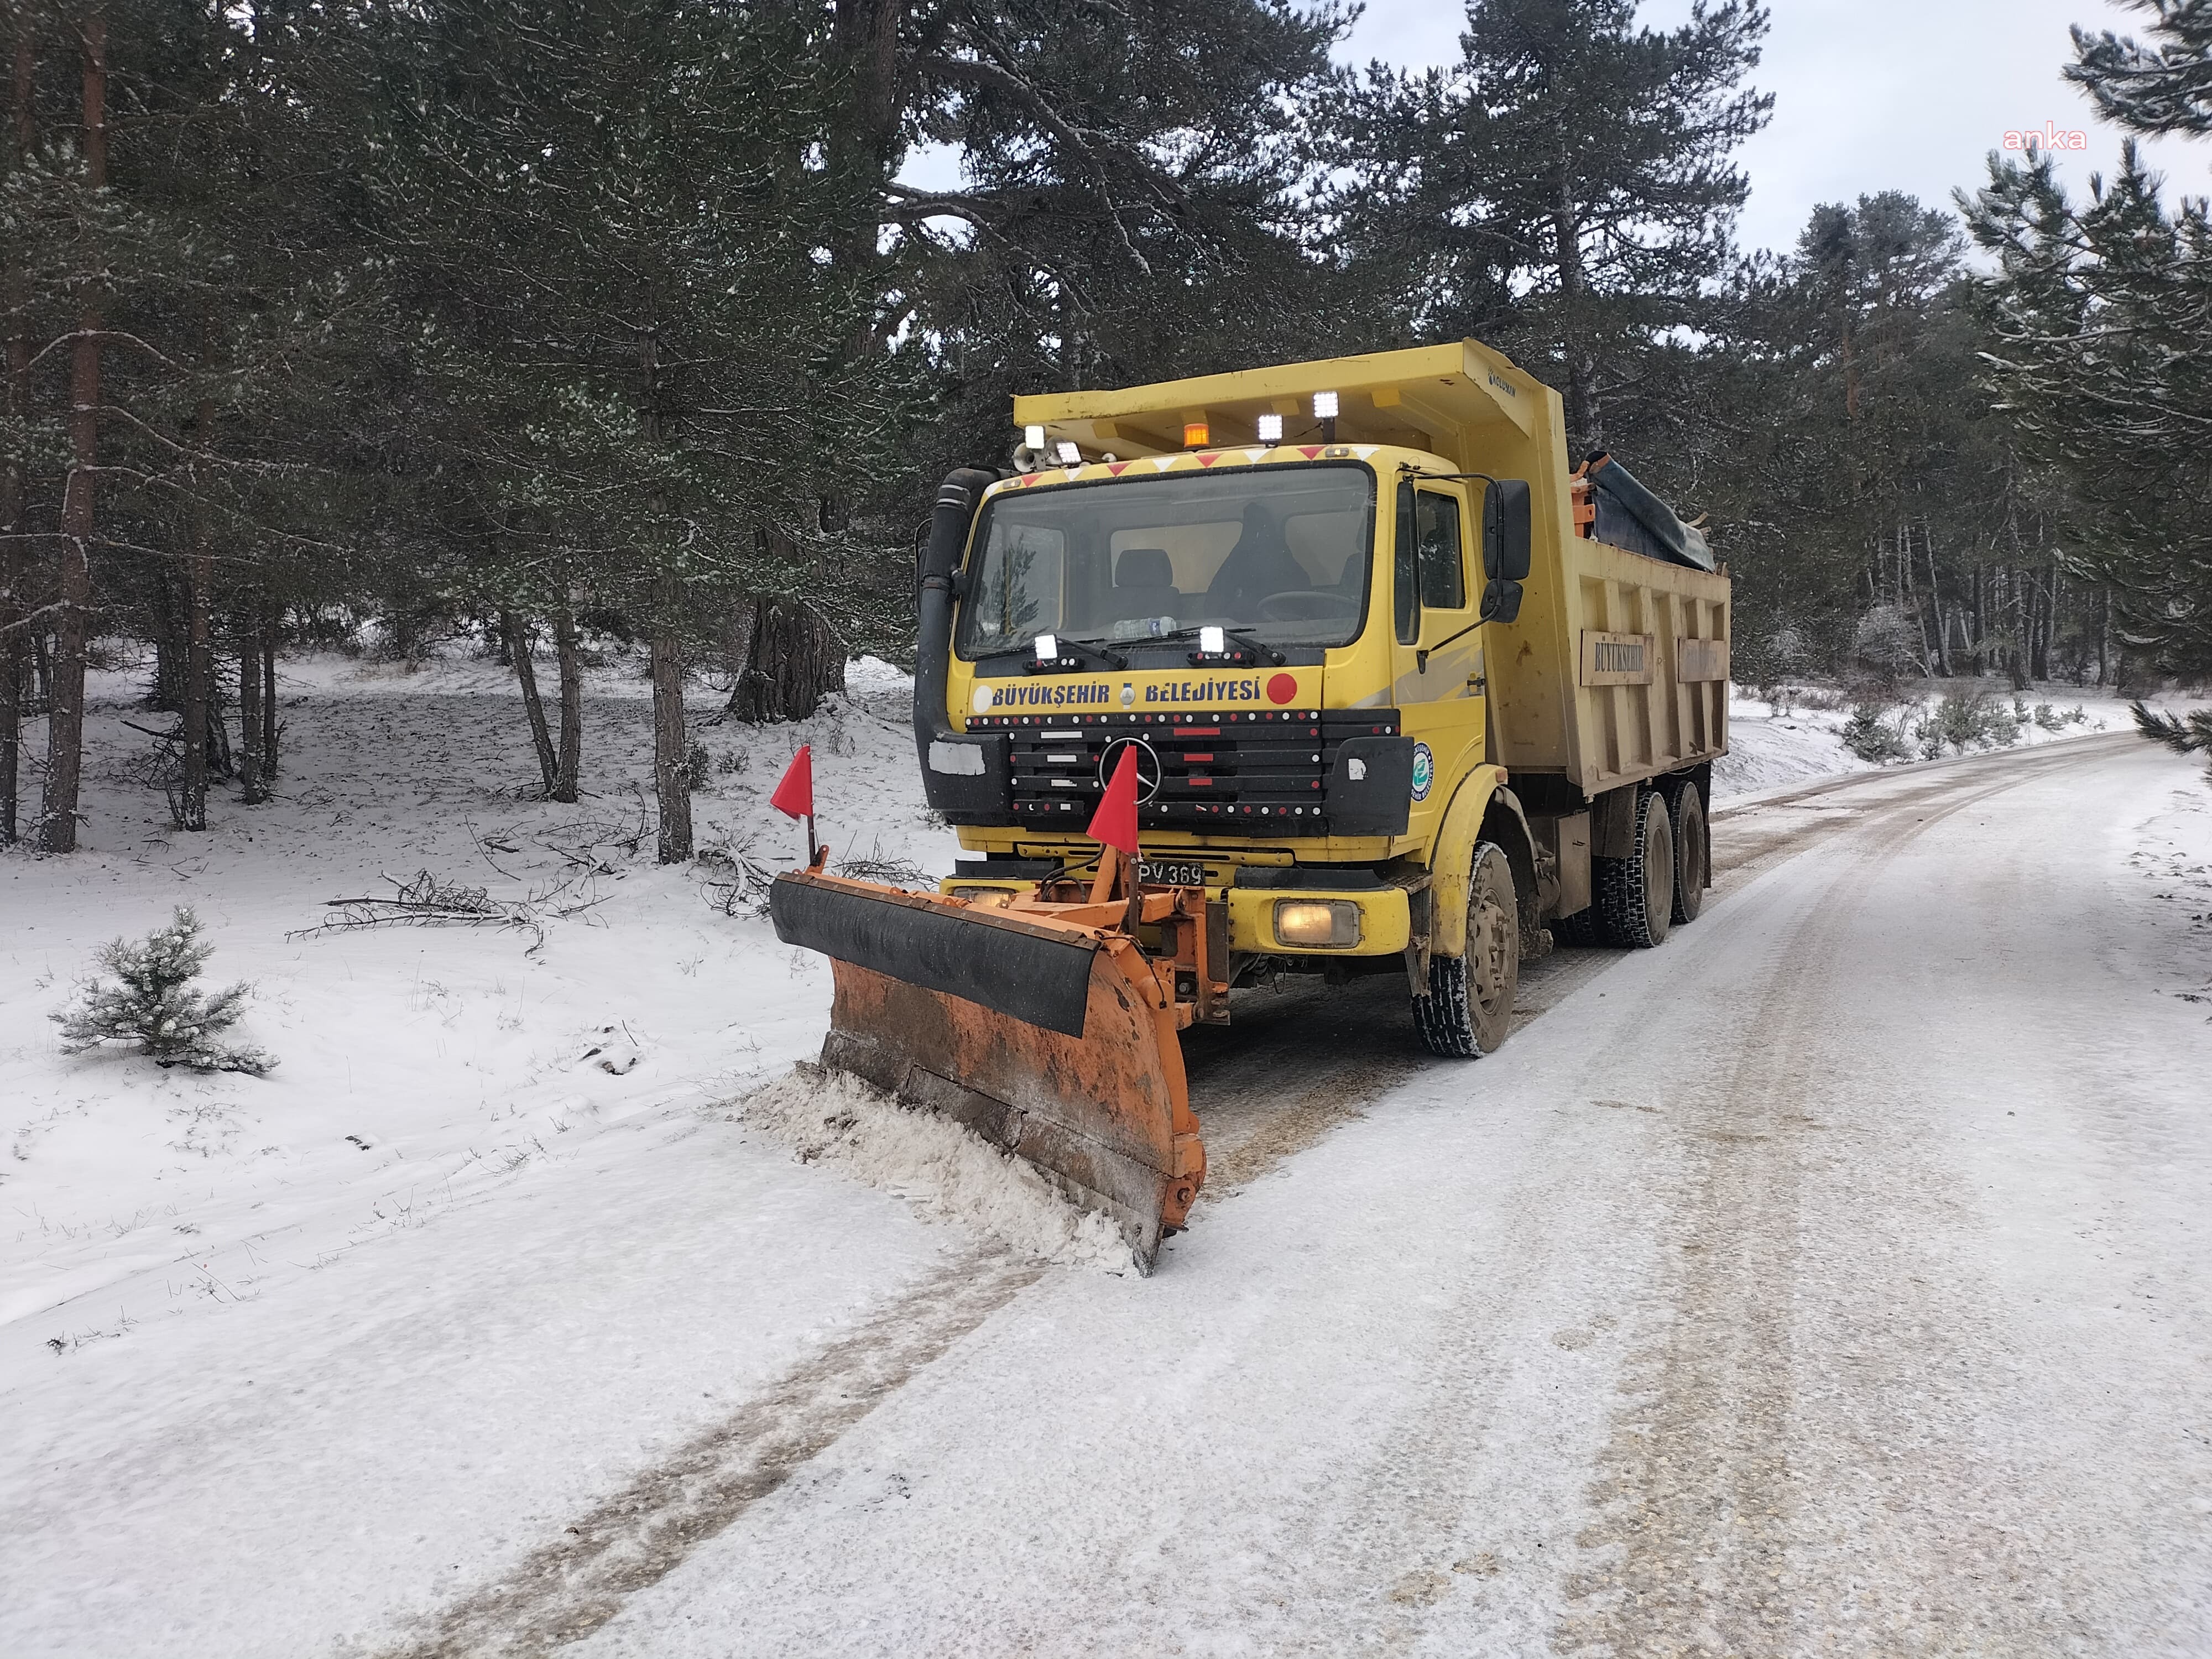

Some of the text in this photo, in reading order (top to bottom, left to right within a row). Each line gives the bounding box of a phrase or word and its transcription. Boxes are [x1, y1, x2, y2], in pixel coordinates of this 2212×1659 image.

[992, 676, 1260, 708] BÜYÜKŞEHİR BELEDİYESİ
[1138, 864, 1202, 885] PV 369
